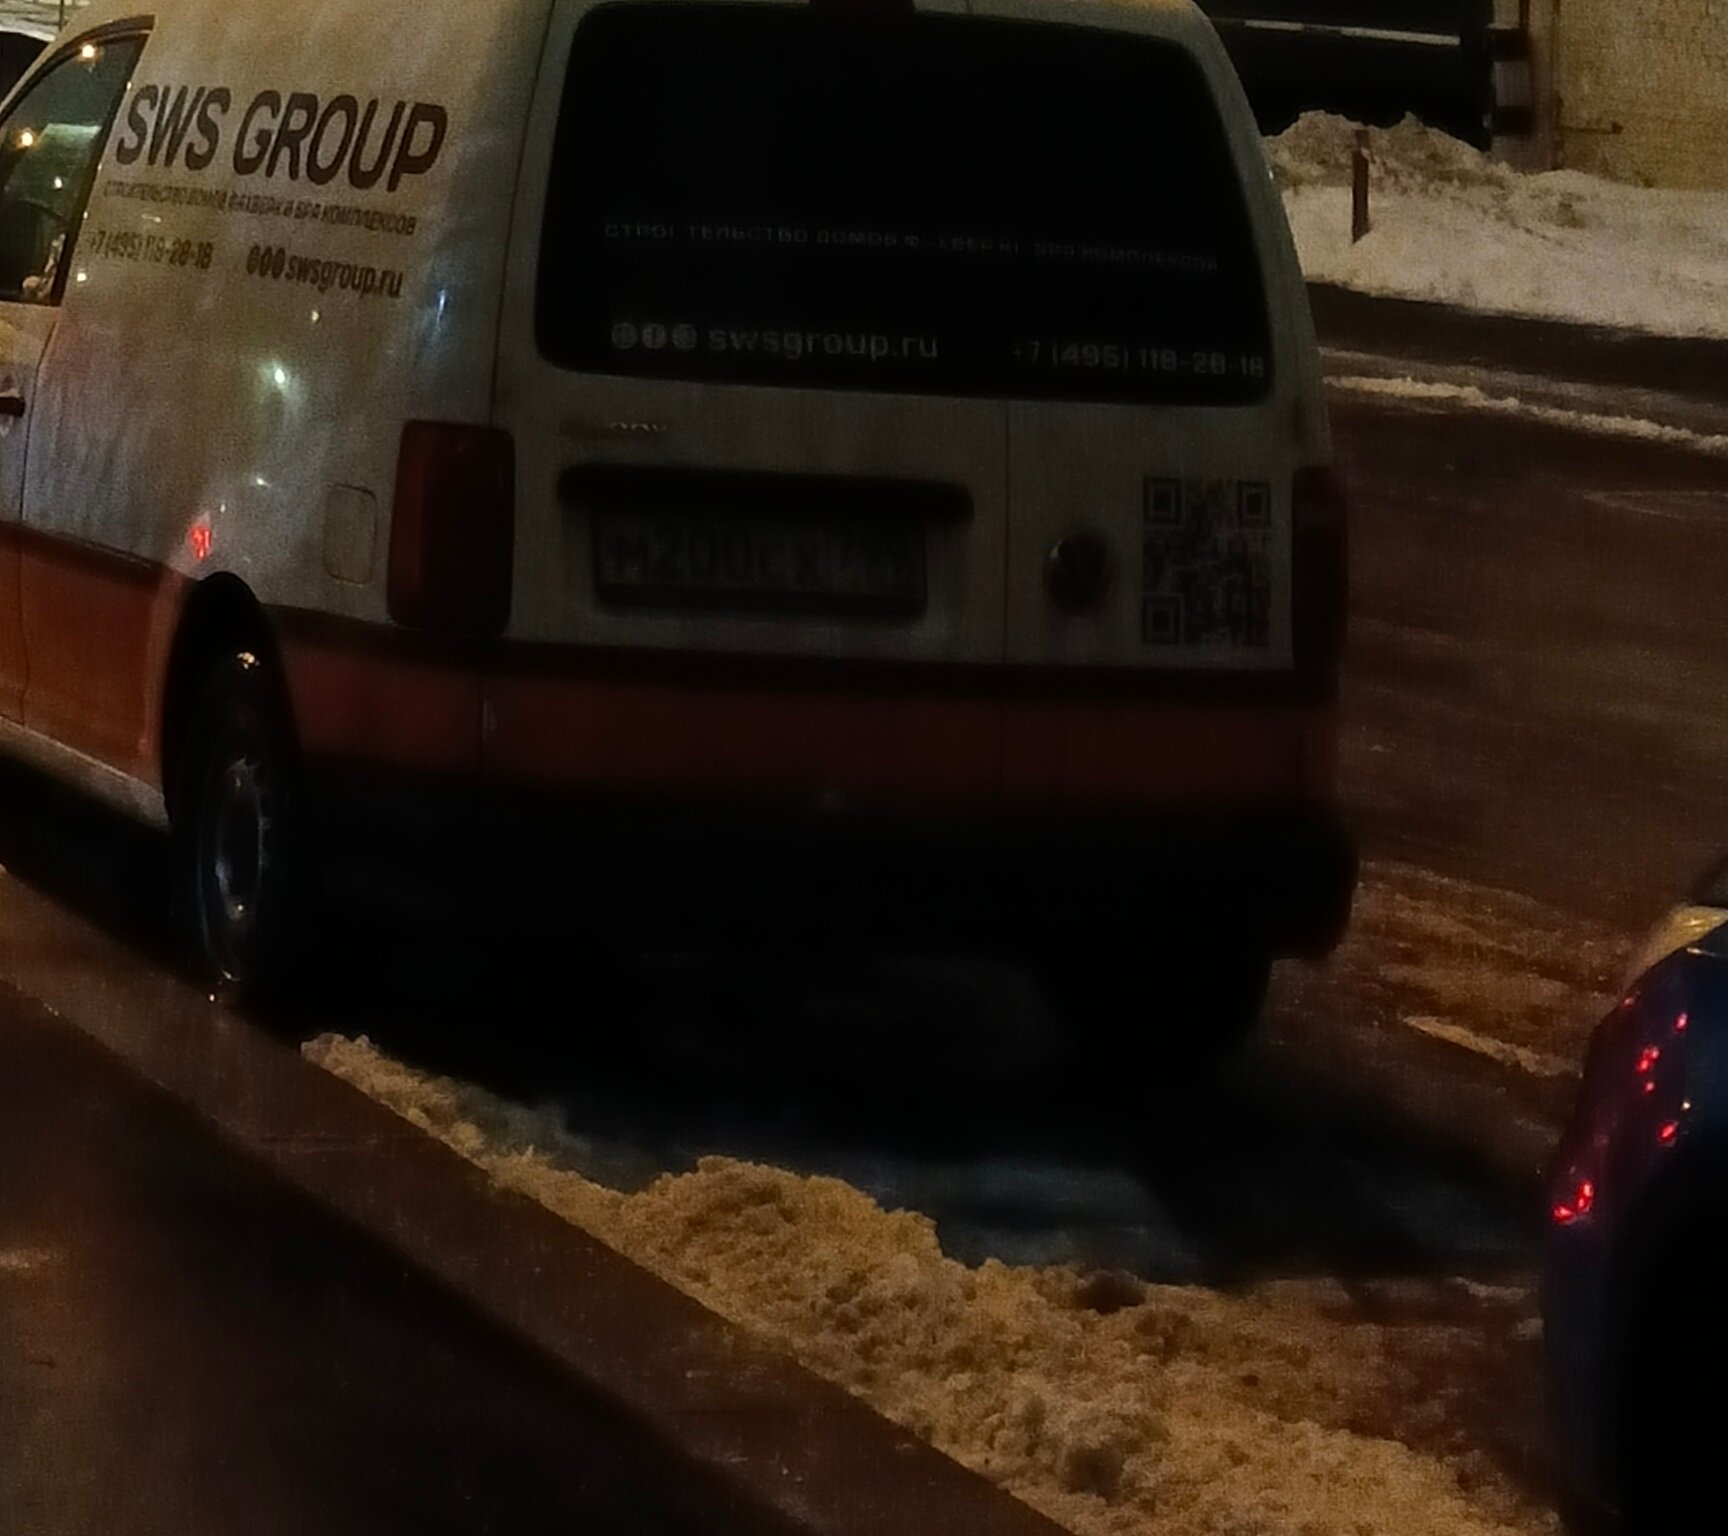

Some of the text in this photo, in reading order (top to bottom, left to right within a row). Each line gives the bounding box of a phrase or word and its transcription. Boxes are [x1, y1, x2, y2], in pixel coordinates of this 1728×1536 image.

[115, 84, 448, 193] SWS GROUP
[284, 254, 404, 299] swsgroup.ru
[707, 327, 940, 362] swsgroup.ru
[1011, 339, 1265, 379] +7 (495) 118-28-18
